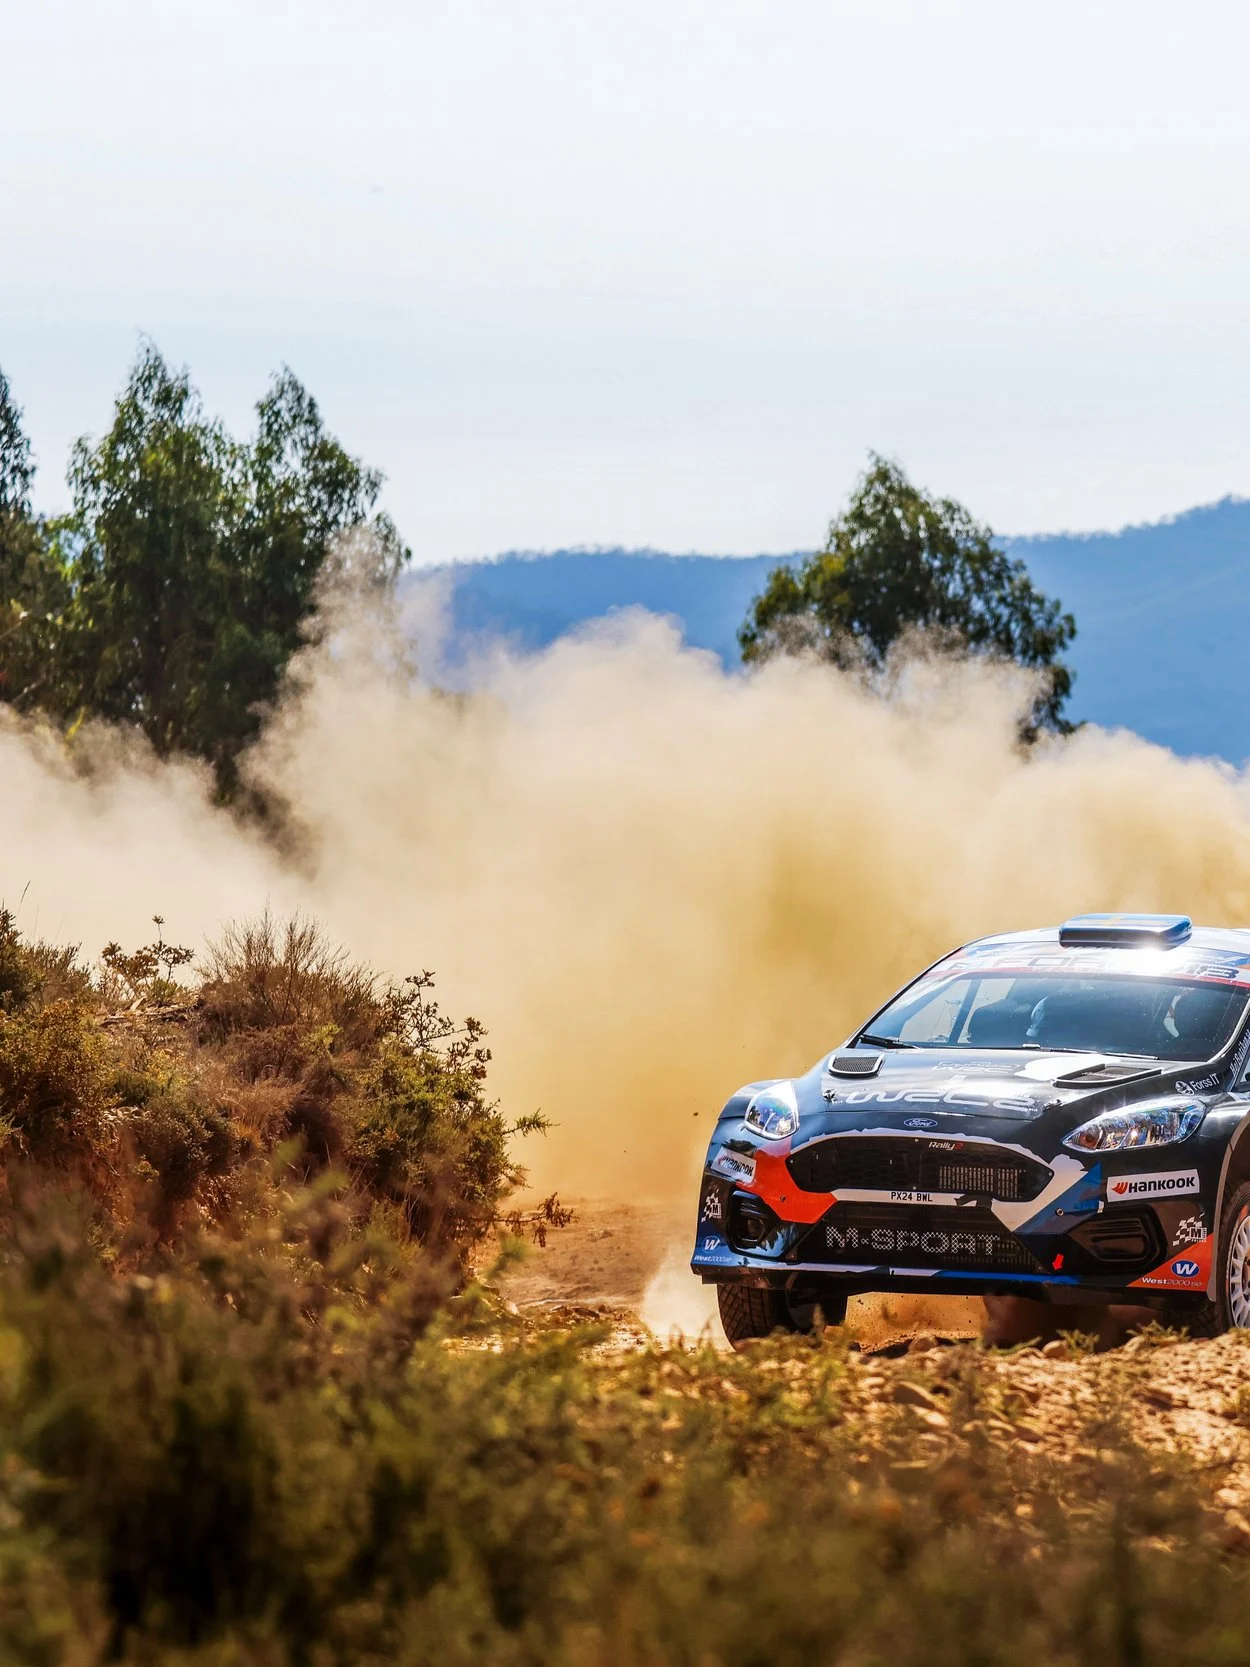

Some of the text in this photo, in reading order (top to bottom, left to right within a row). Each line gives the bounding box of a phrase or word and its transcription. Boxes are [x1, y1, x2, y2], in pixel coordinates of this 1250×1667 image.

[1190, 1073, 1220, 1091] Forss IT
[908, 1119, 931, 1127] Ford
[928, 1141, 963, 1150] Rally2
[891, 1191, 934, 1202] PX24 BWL
[704, 1238, 721, 1250] W
[1176, 1263, 1198, 1275] W
